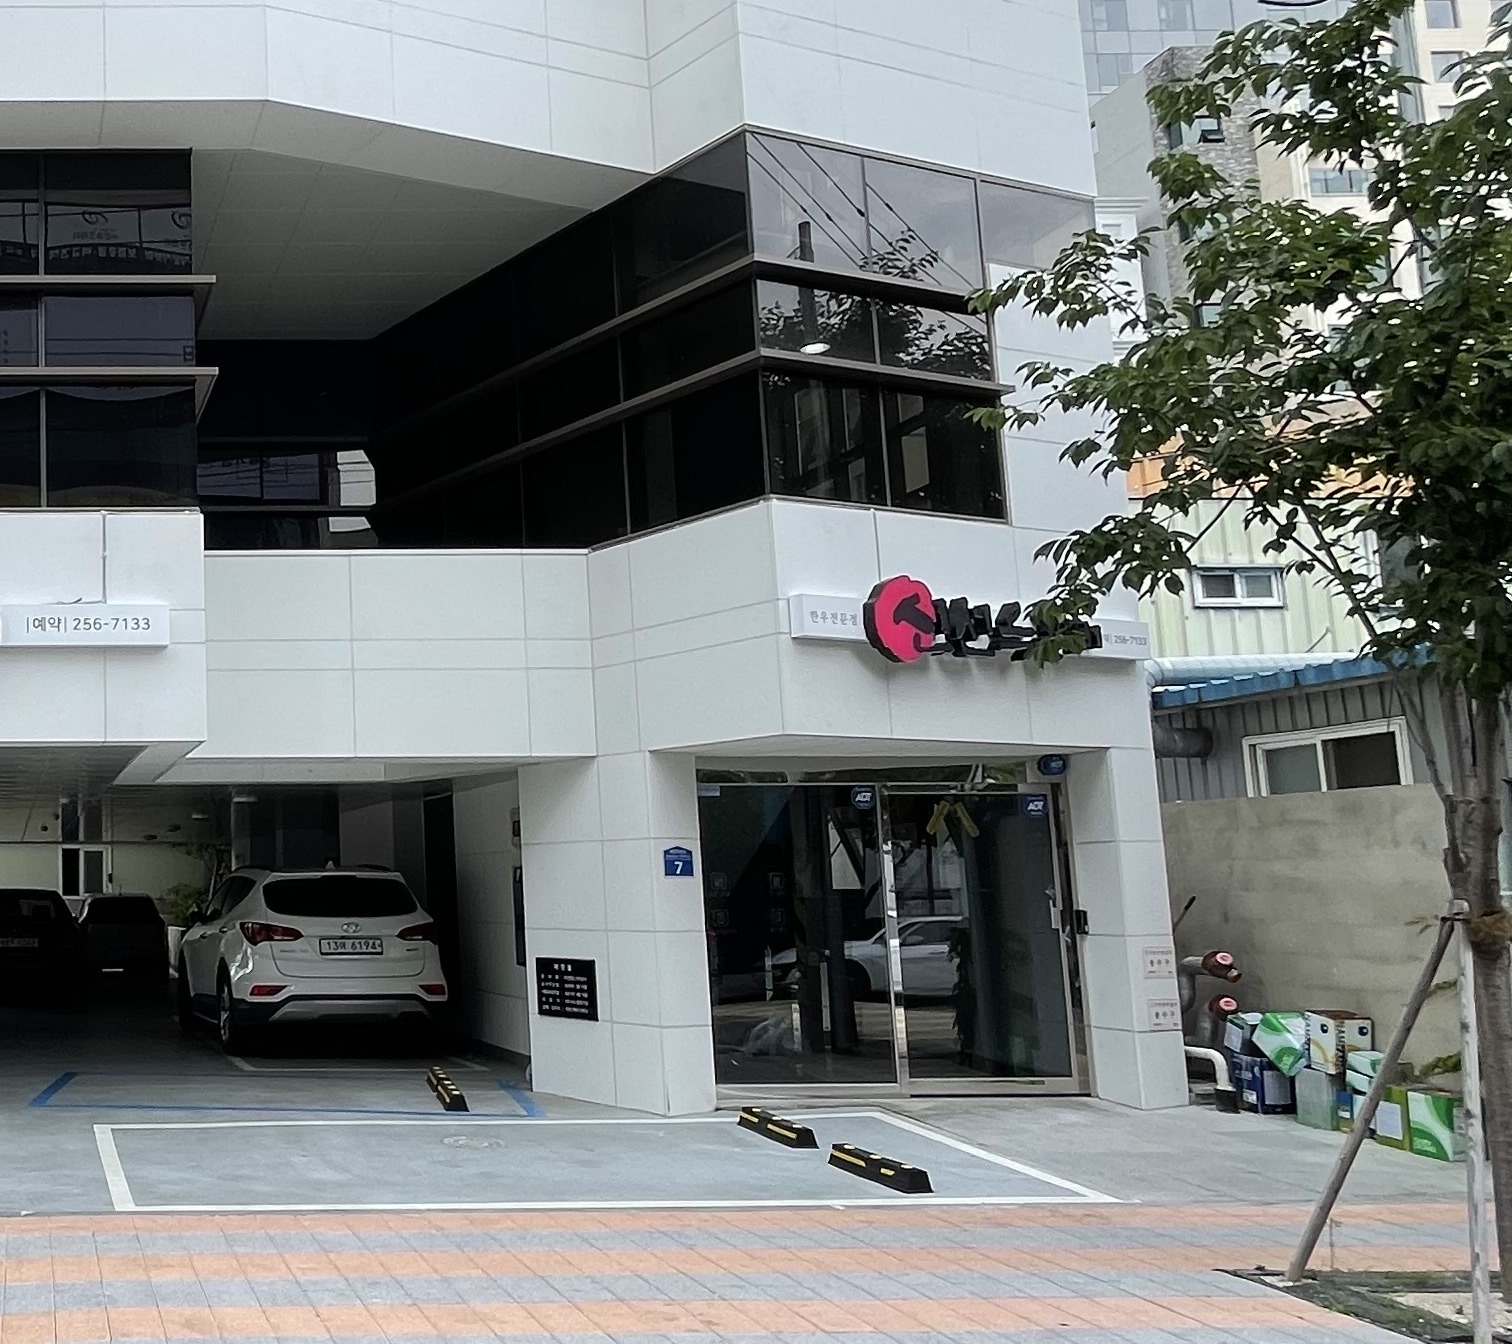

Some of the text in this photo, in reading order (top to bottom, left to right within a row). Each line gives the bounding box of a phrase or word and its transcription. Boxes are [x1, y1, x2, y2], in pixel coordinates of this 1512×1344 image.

[809, 610, 858, 626] 한우전문점
[72, 617, 152, 632] 256-7133
[855, 792, 872, 802] ADT
[1027, 801, 1044, 811] ADT
[674, 861, 683, 875] 7
[351, 940, 377, 951] 6194
